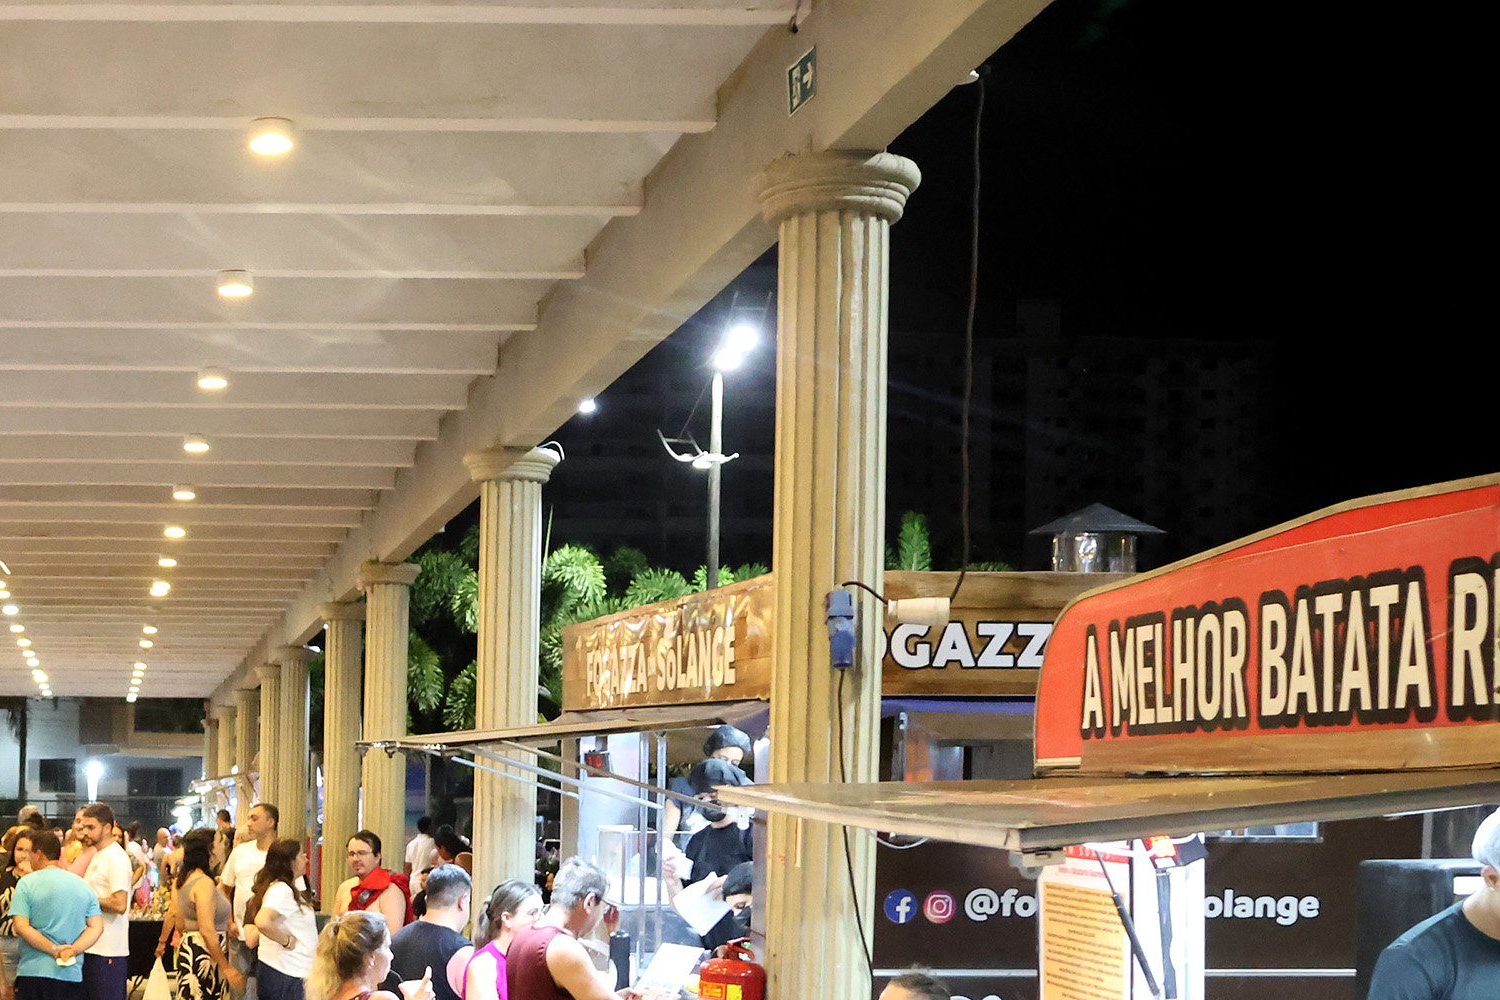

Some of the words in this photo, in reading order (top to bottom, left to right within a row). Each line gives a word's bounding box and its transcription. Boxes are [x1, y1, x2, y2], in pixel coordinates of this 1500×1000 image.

[882, 621, 1053, 669] GAZZ
[1081, 634, 1104, 730] A
[1110, 608, 1248, 728] MELHOR
[1260, 580, 1432, 718] BATATA
[1451, 570, 1500, 707] R
